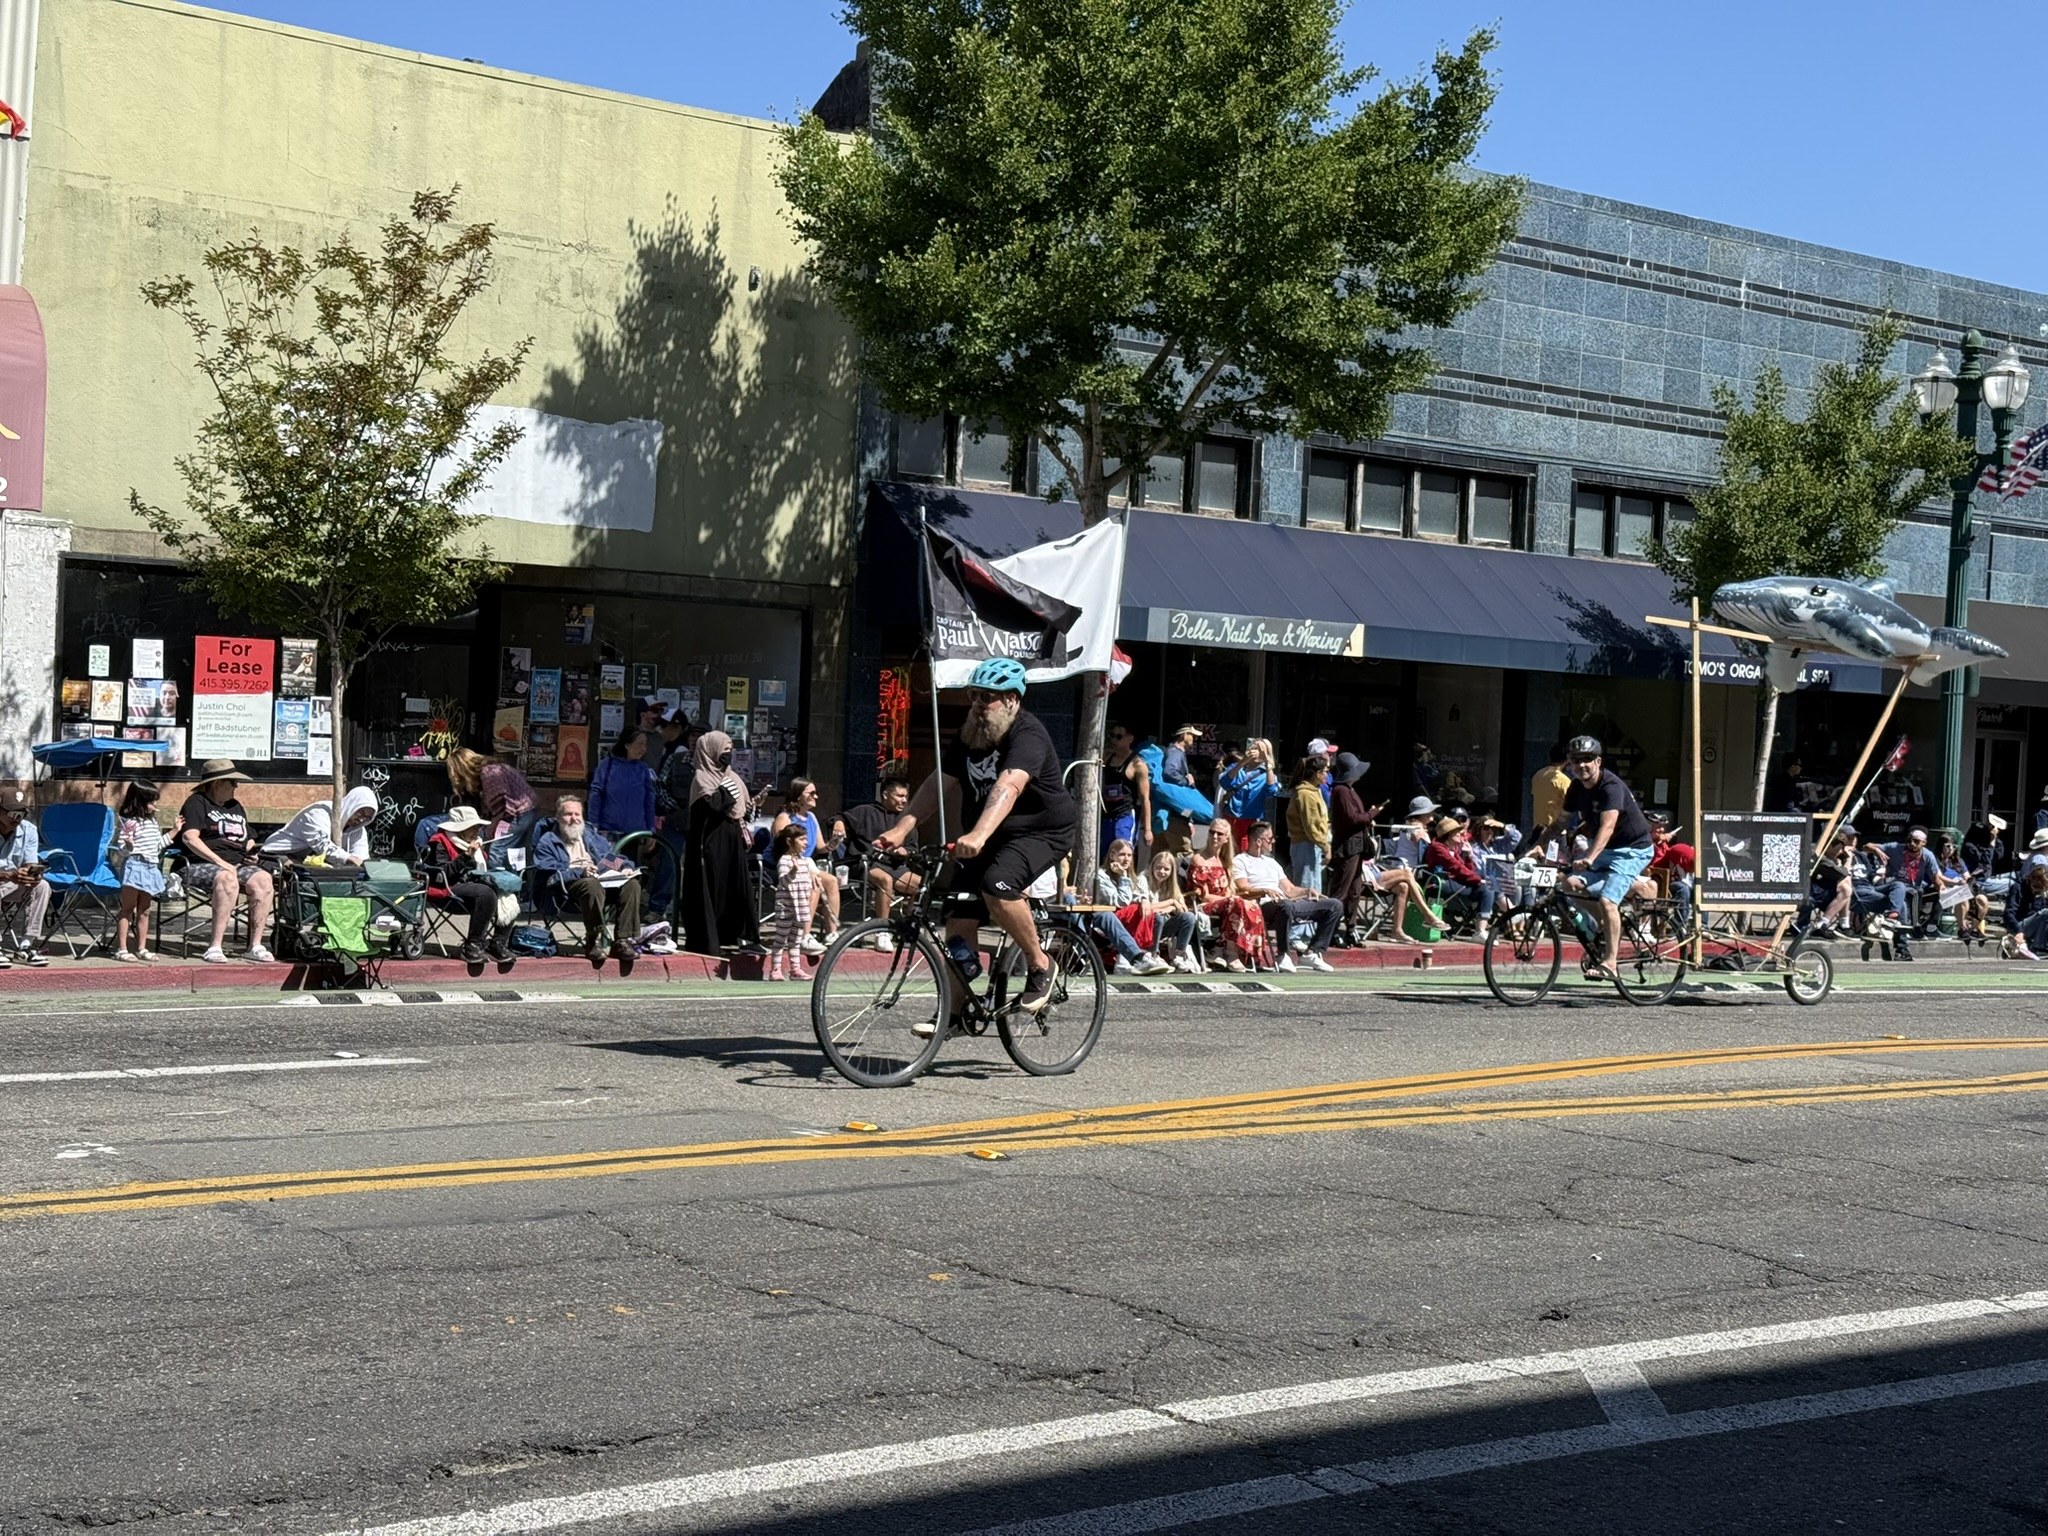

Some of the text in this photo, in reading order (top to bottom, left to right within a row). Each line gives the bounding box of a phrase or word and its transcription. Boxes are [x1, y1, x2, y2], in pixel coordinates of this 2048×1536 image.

[936, 616, 965, 629] CAPTAIN
[937, 621, 1042, 656] Paul Watso
[1172, 612, 1344, 655] Bella Nail Spa & Waxing
[220, 640, 252, 657] For
[207, 657, 263, 675] Lease
[1729, 663, 1764, 680] ORGA
[1811, 668, 1830, 684] SPA
[199, 678, 269, 691] 415.395.7262
[729, 680, 746, 688] IMP
[197, 702, 246, 711] Justin Choi
[196, 723, 261, 733] Jeff Badstubner
[255, 749, 268, 757] JLL
[1872, 810, 1911, 822] Wednesday
[1882, 823, 1900, 834] 7 pm
[1537, 869, 1551, 884] 75
